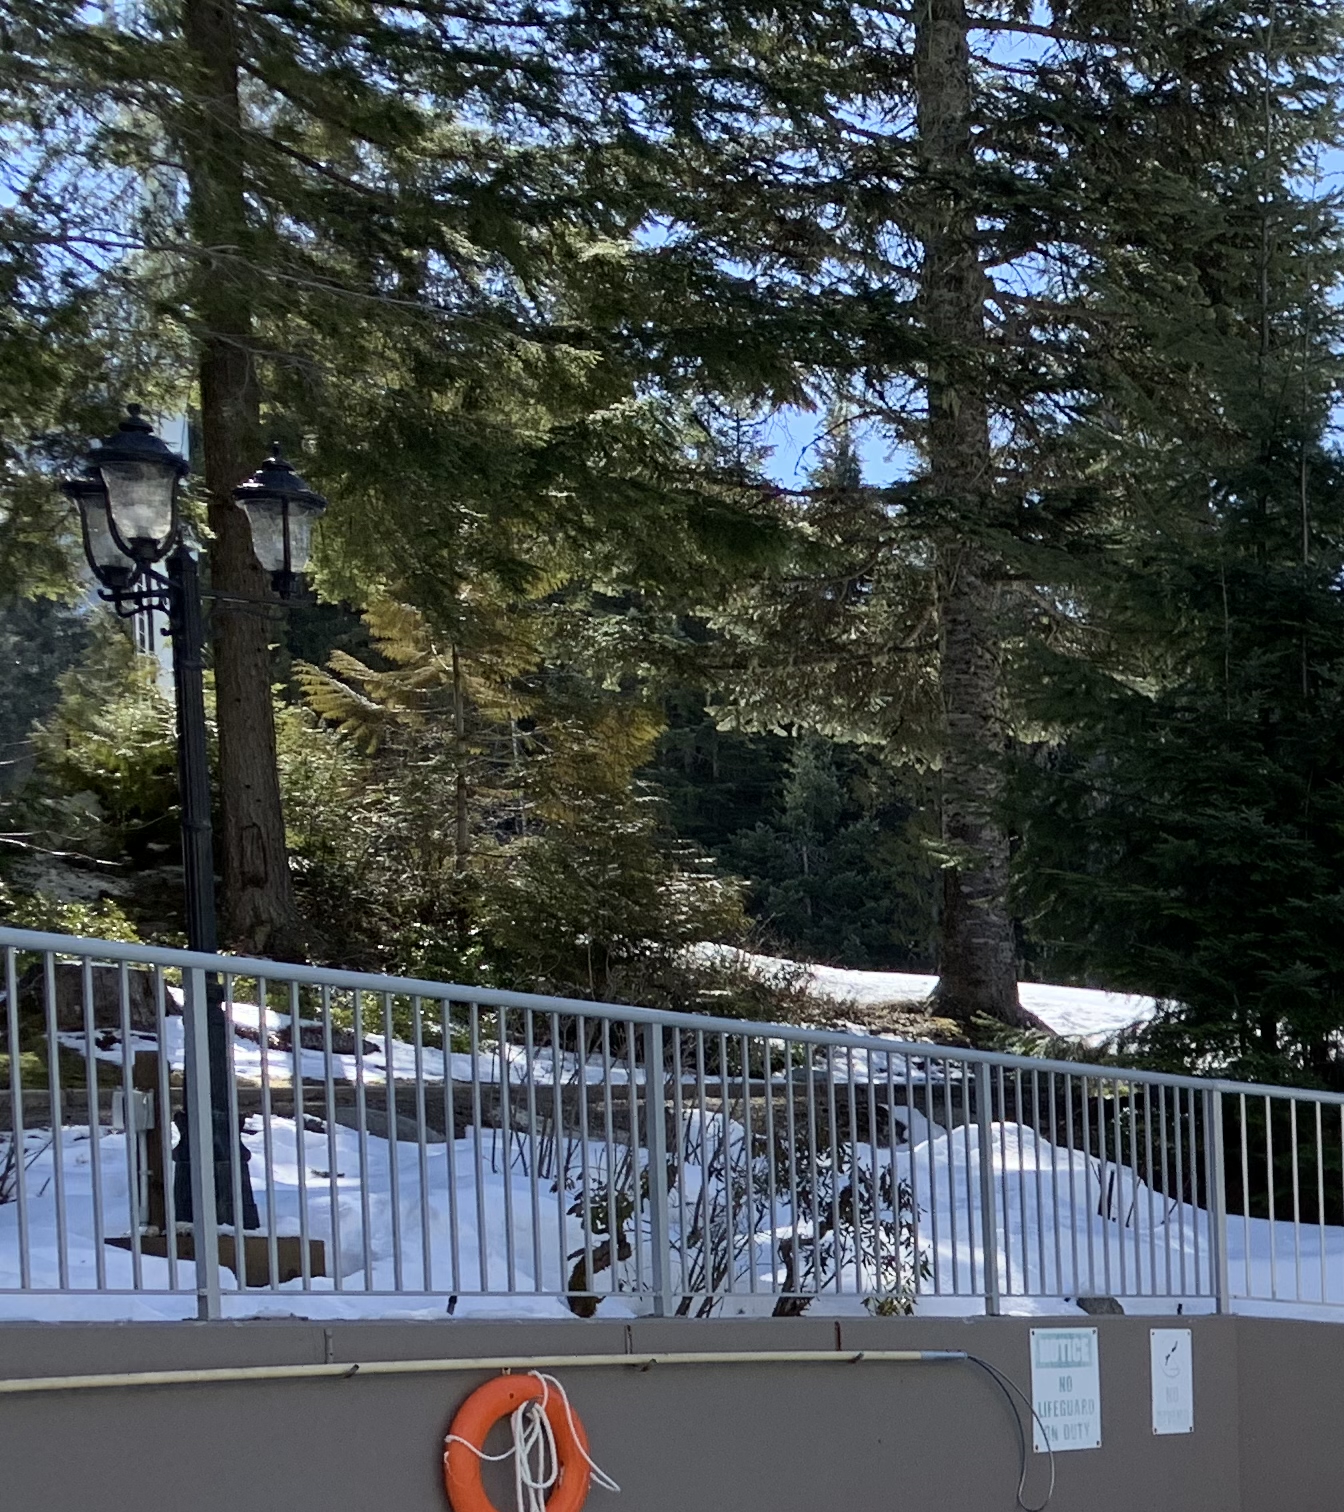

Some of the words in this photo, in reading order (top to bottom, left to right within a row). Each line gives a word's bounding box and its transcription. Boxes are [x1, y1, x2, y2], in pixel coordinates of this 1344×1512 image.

[1058, 1375, 1073, 1393] NO
[1037, 1399, 1095, 1418] LIFEGUARD
[1044, 1424, 1058, 1442] ON
[1063, 1422, 1090, 1440] DUTY
